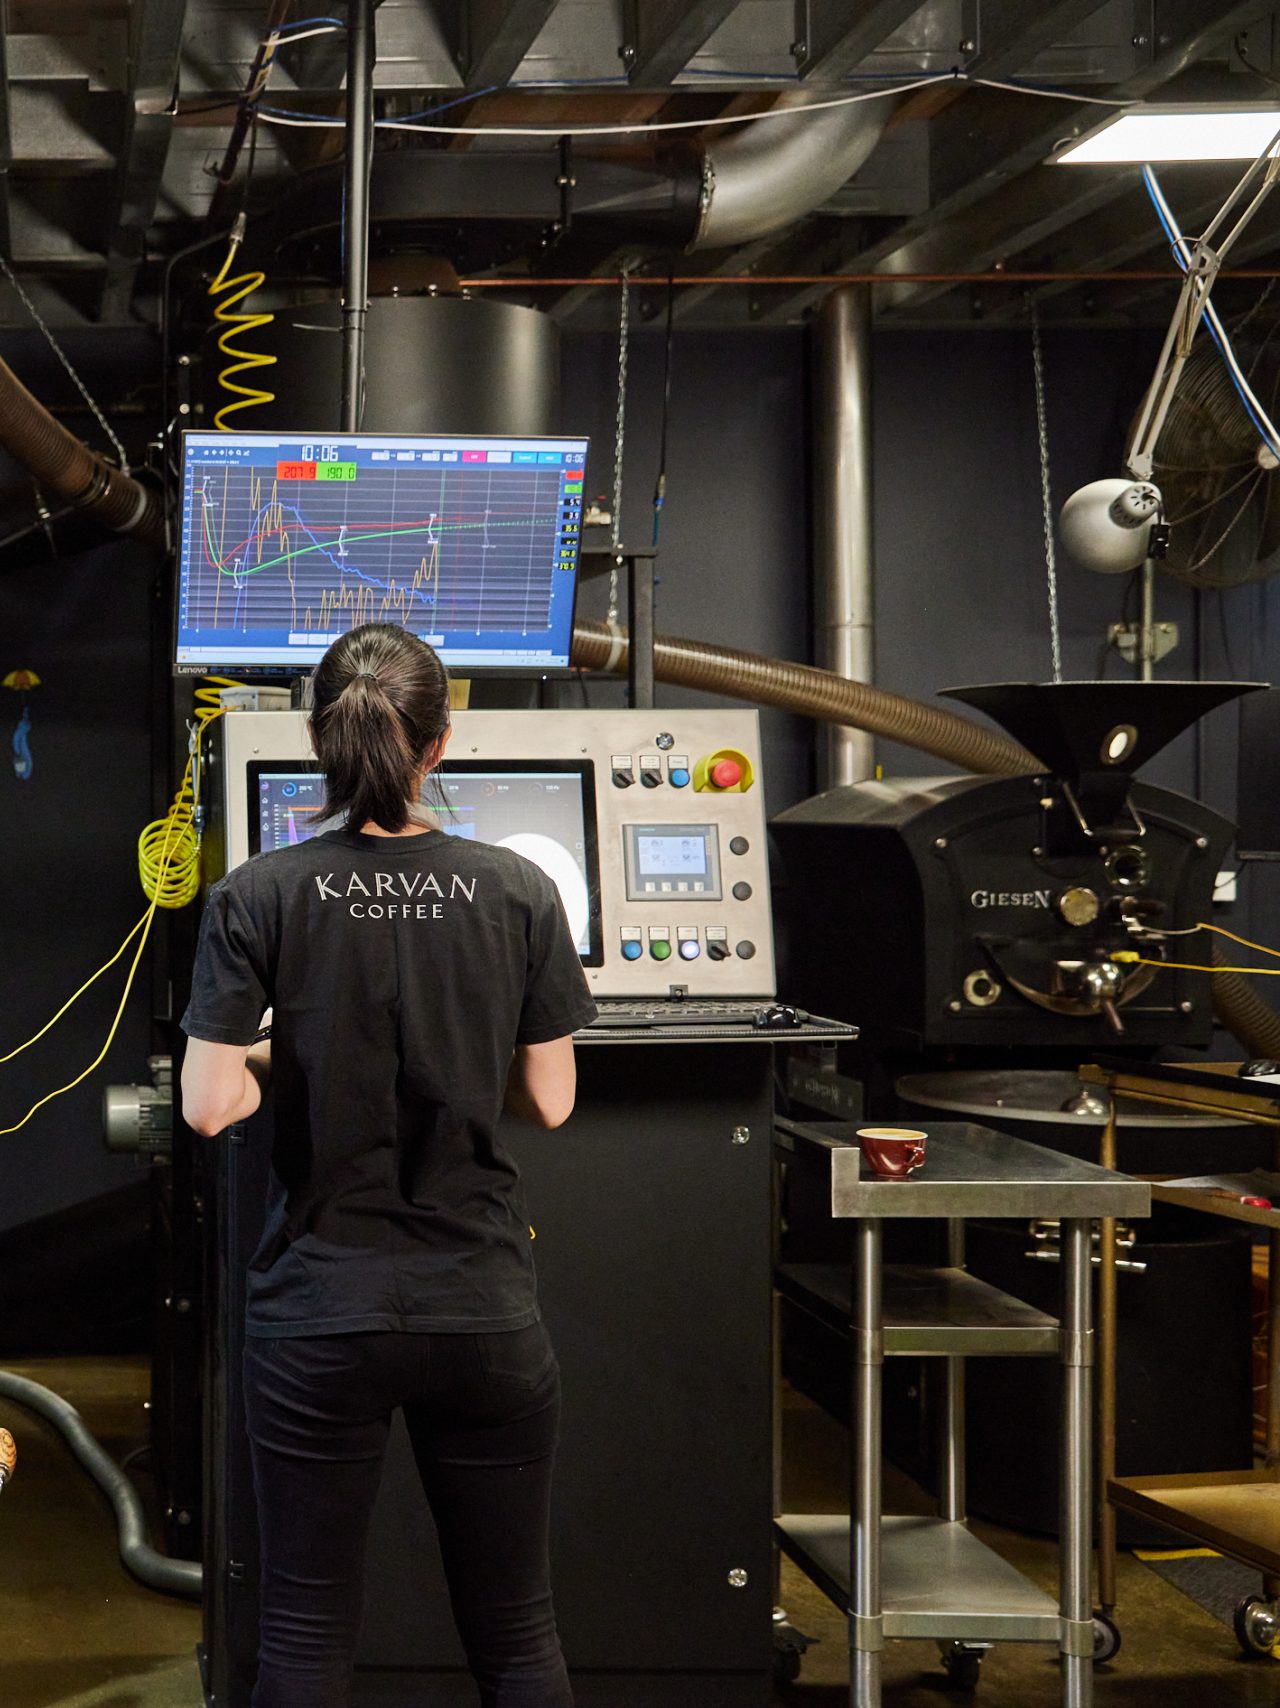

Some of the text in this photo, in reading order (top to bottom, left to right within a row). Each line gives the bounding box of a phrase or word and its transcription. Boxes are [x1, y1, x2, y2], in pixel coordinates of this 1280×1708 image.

[302, 445, 339, 462] 10:06
[177, 666, 208, 674] Lenovo
[315, 871, 477, 903] KARVAN
[970, 889, 1051, 909] GIESEN
[349, 903, 444, 919] COFFEE
